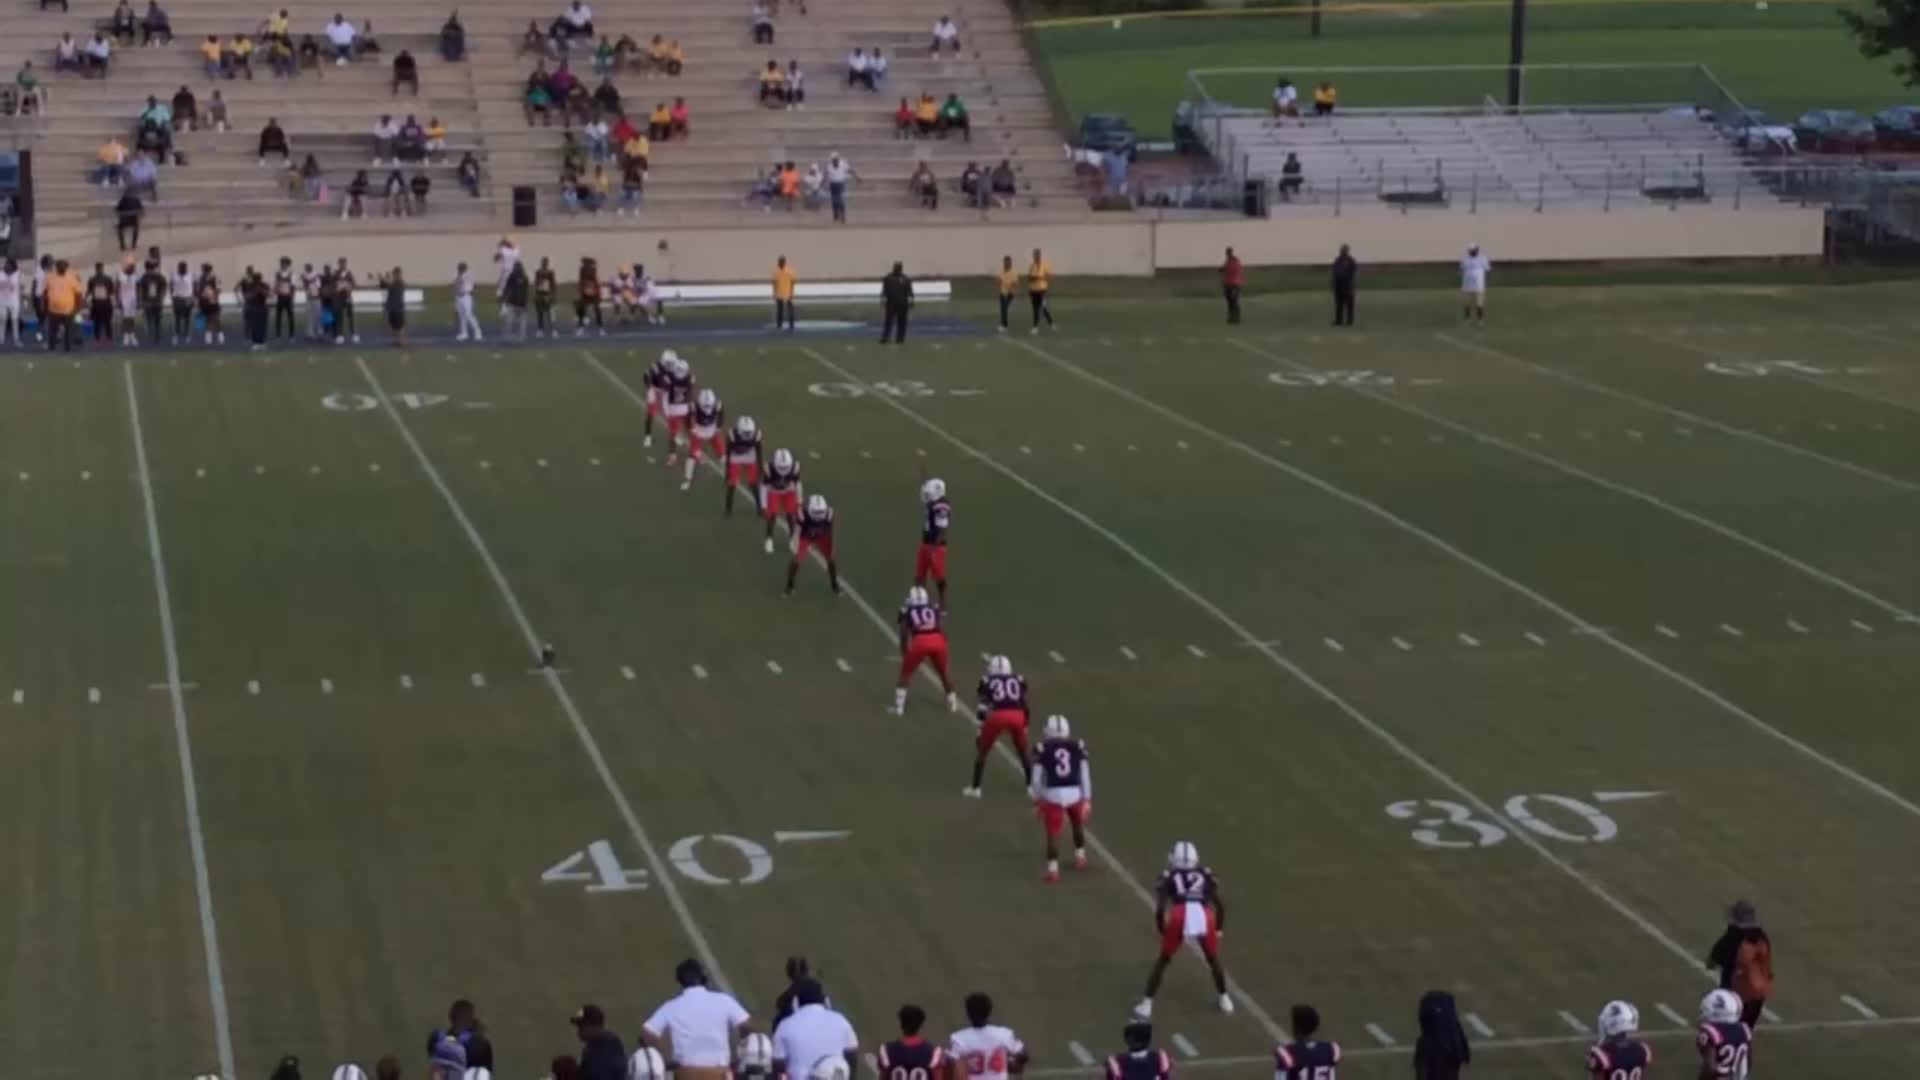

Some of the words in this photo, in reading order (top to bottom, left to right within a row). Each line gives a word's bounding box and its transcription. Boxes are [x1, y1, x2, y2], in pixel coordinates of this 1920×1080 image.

[321, 392, 449, 411] 40
[911, 608, 936, 630] 19
[989, 678, 1020, 701] 30
[1054, 748, 1071, 777] 3
[1385, 793, 1618, 847] 30
[541, 833, 774, 893] 40
[1174, 871, 1205, 898] 12
